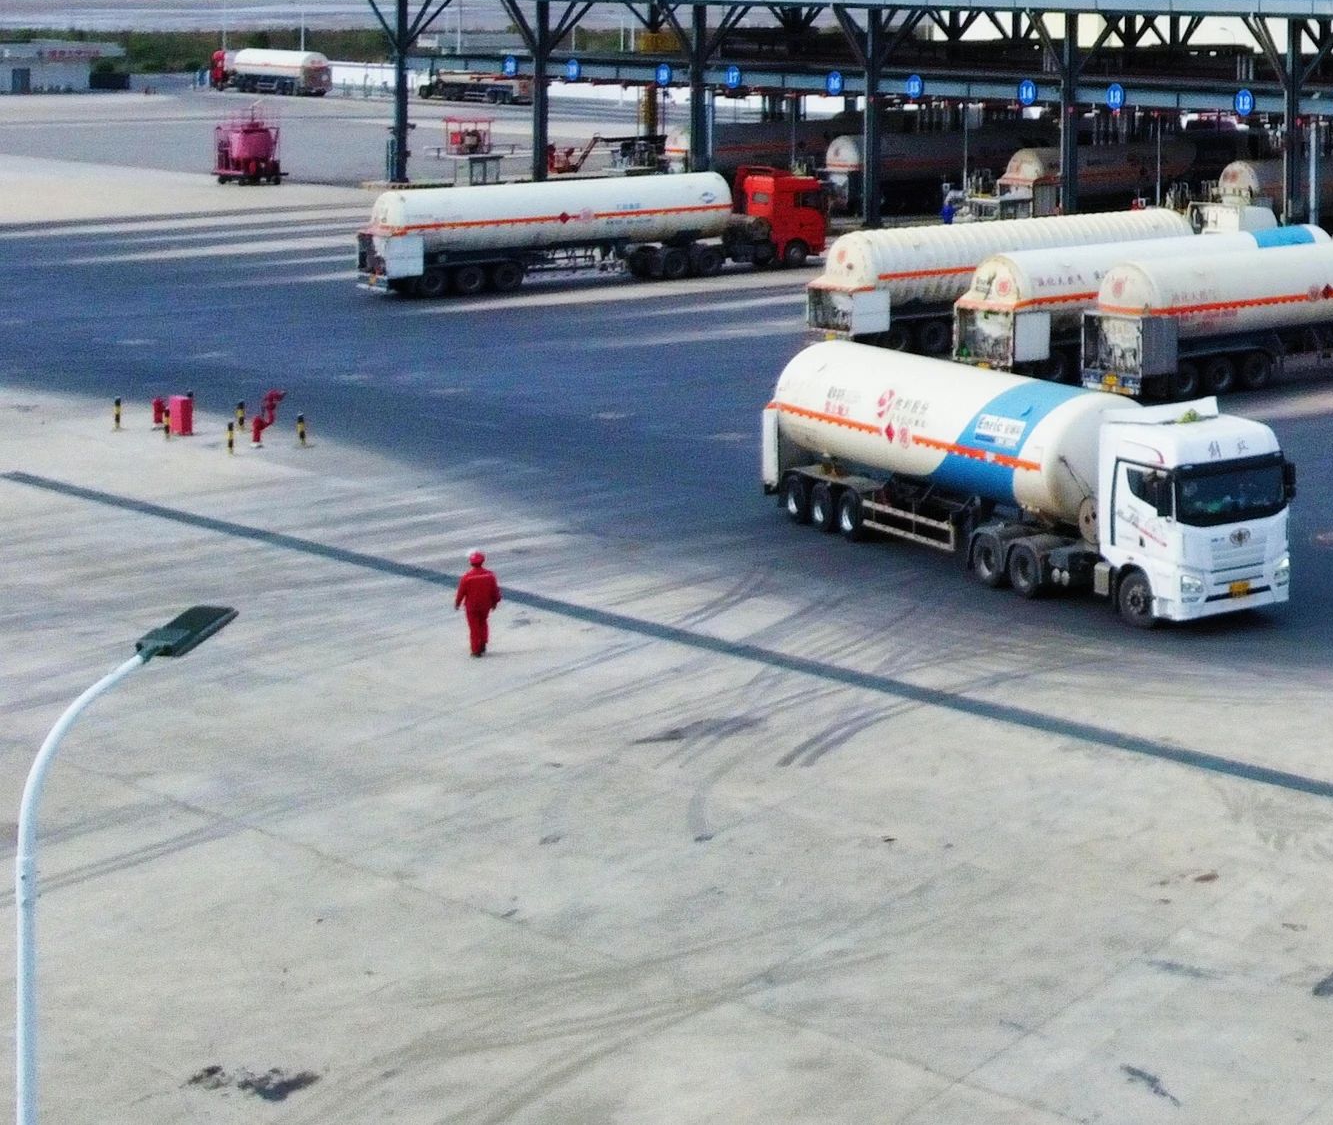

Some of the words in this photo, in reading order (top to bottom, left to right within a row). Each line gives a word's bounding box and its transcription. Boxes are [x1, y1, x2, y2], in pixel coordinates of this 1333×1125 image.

[728, 71, 739, 84] 17
[1022, 86, 1033, 99] 14
[1109, 90, 1121, 103] 13
[1239, 96, 1251, 110] 12
